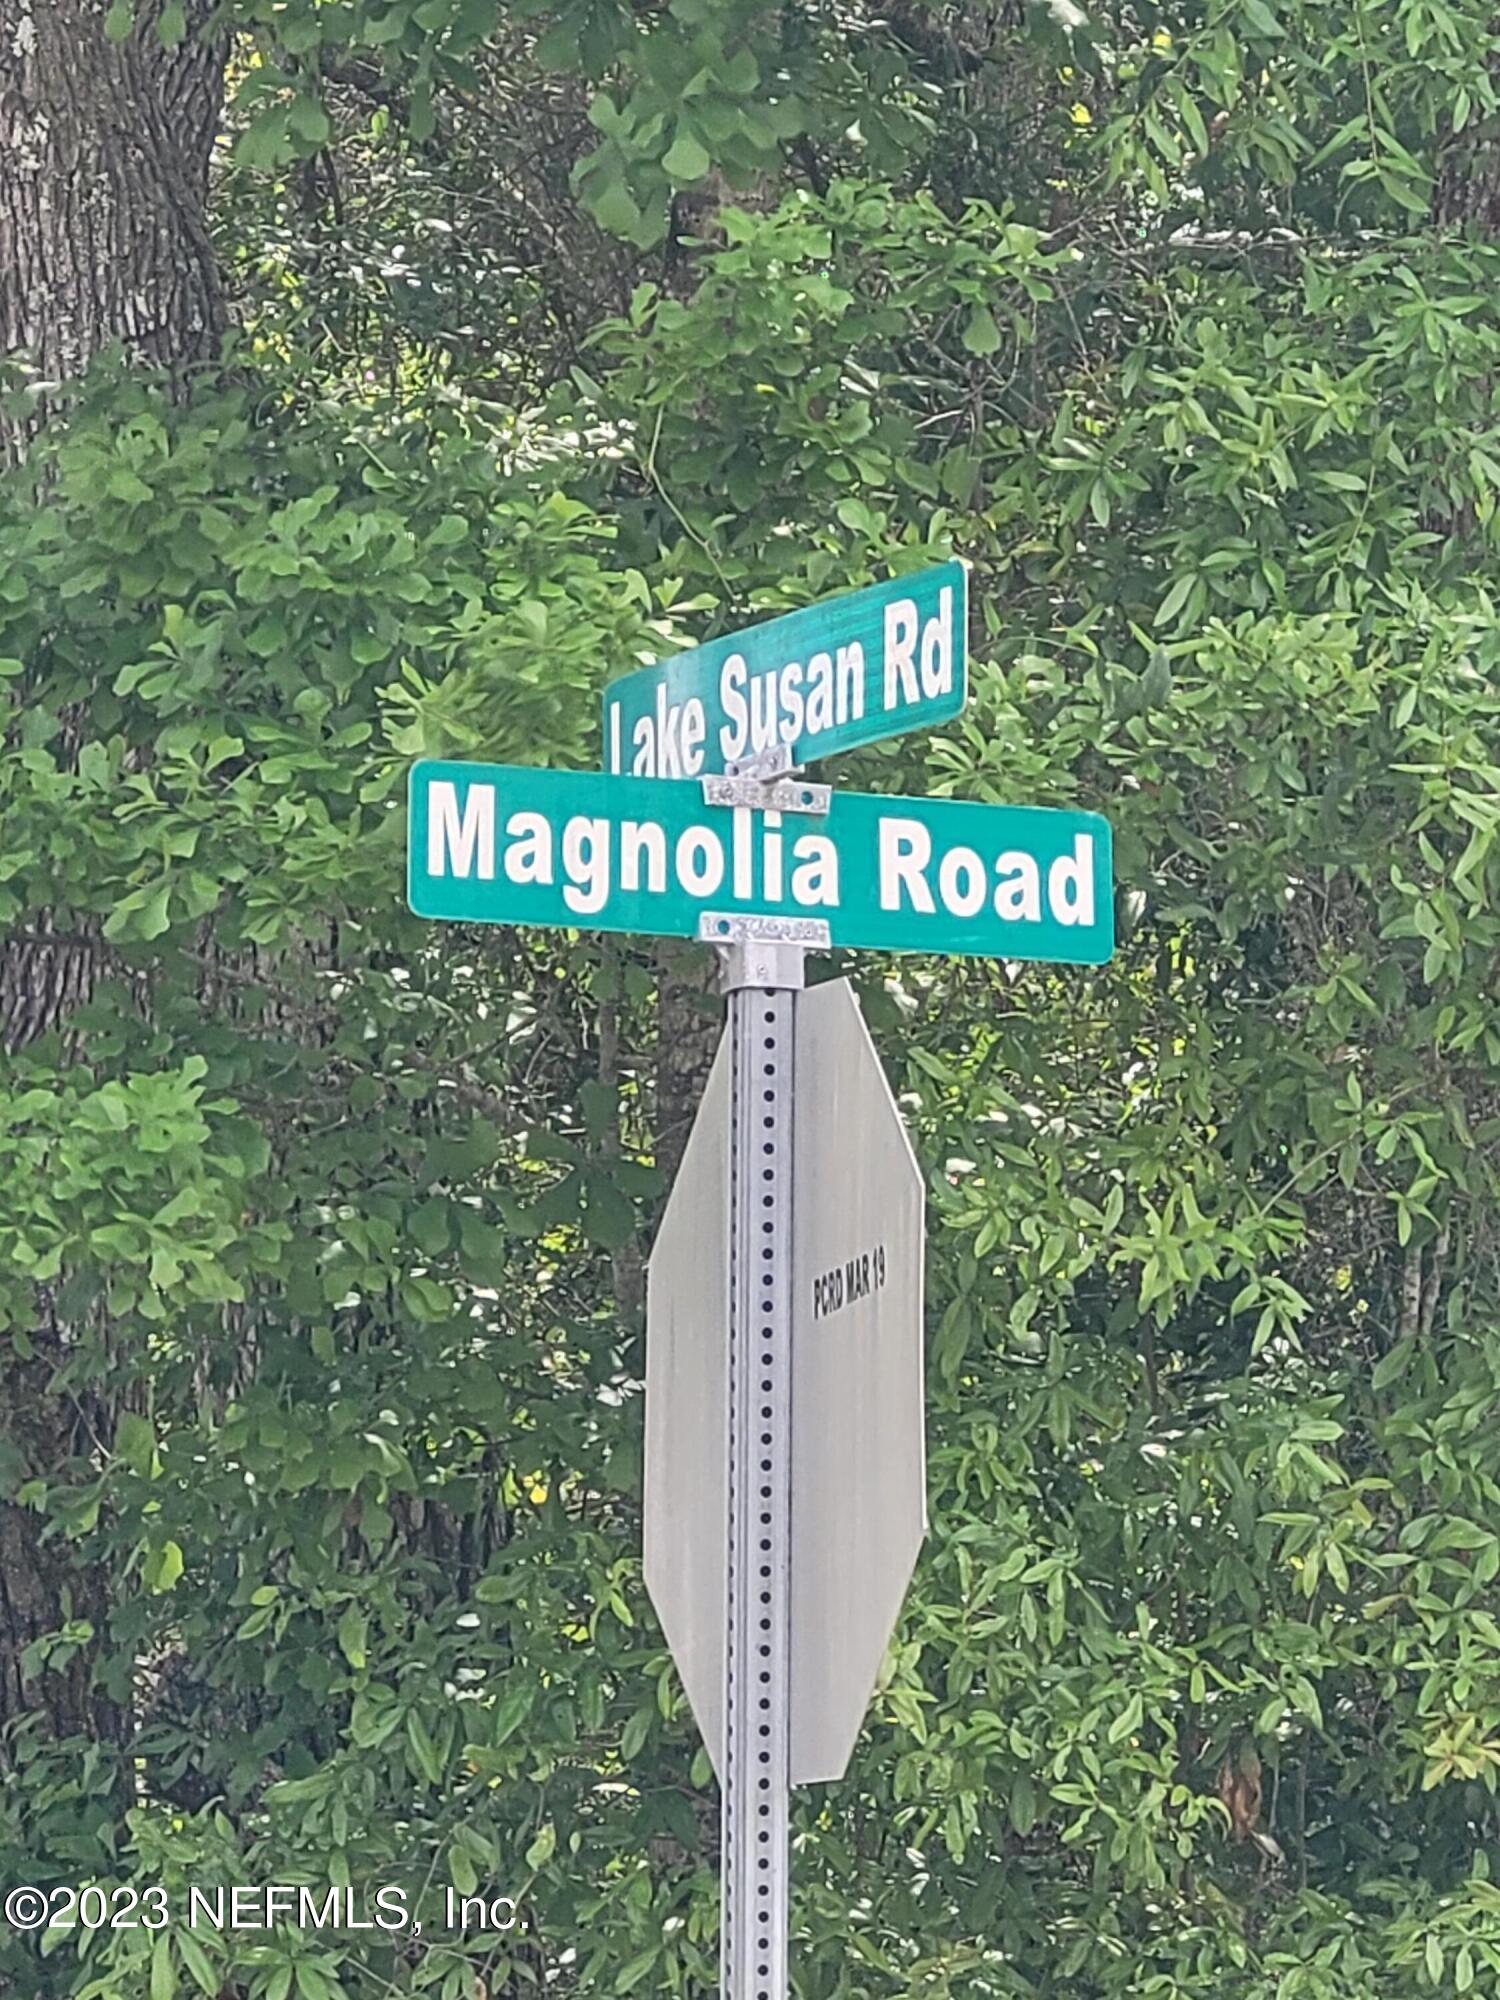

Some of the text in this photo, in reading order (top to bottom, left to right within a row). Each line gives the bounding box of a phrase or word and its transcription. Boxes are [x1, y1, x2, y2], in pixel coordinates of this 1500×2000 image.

[610, 586, 953, 778] Lake Susan Rd
[427, 781, 1096, 926] Magnolia Road
[814, 1245, 885, 1320] PCRD MAR 19
